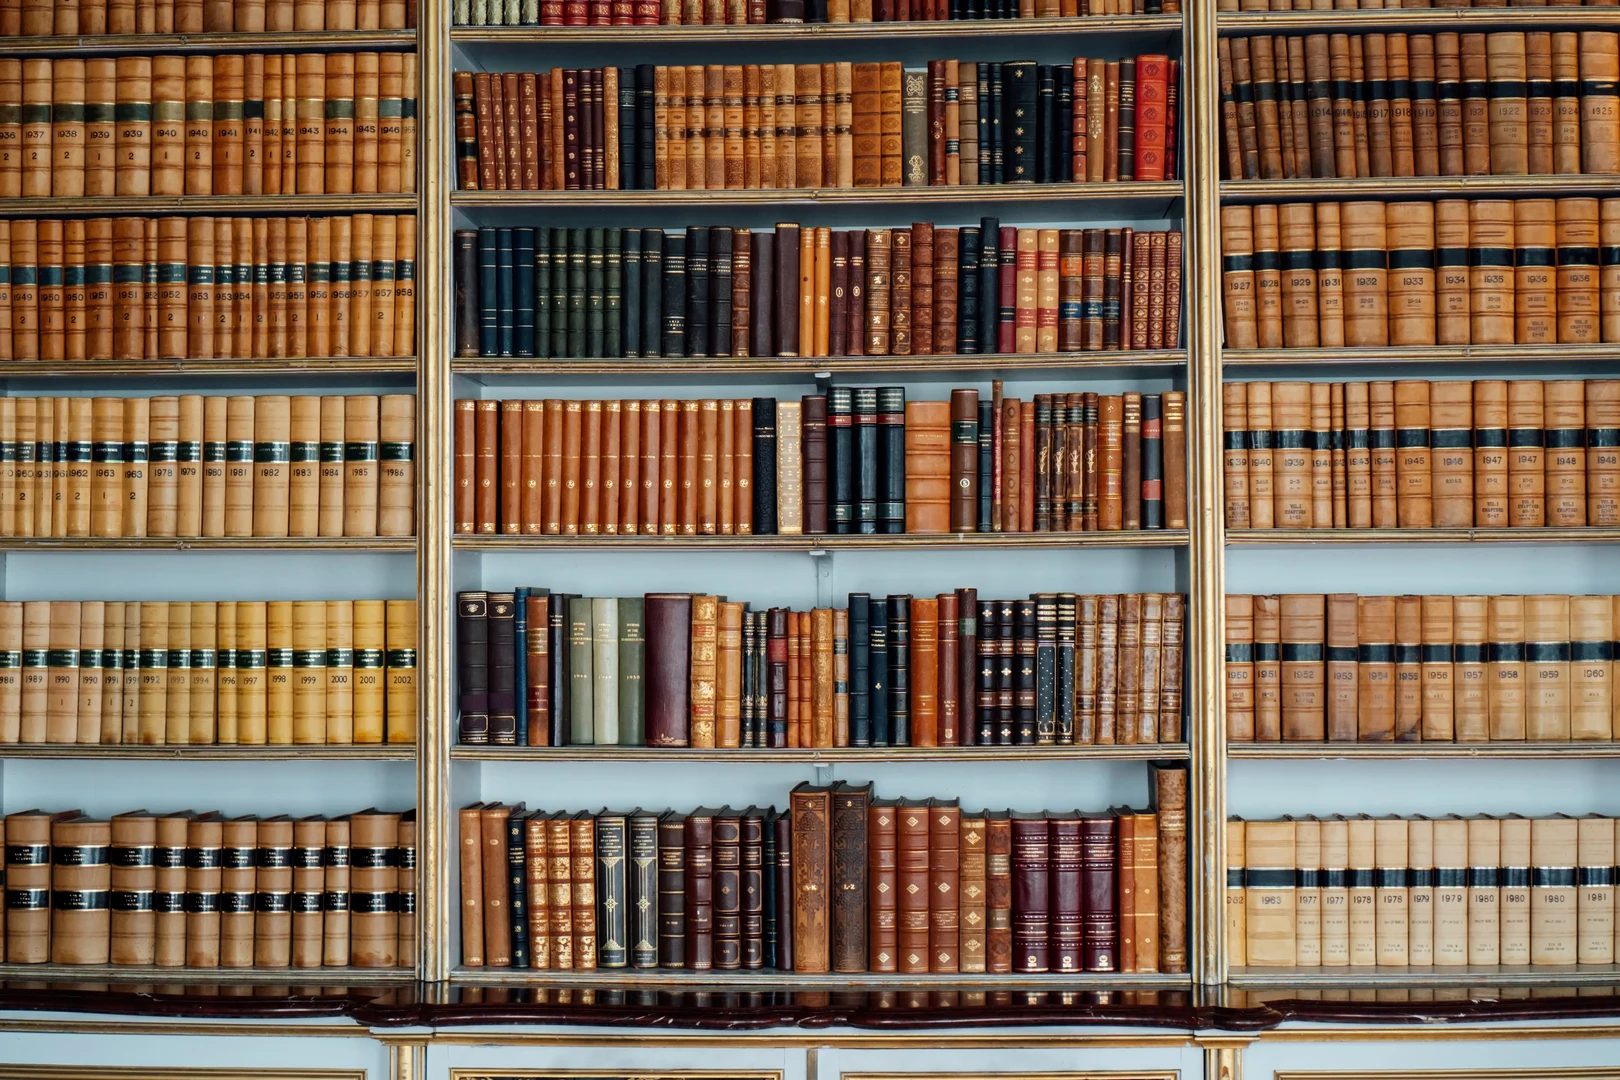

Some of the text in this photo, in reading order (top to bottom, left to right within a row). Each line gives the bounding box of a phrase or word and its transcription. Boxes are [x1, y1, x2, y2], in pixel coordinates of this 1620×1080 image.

[1311, 108, 1332, 117] 1914
[1368, 108, 1389, 118] 1917
[1391, 108, 1411, 117] 1918
[1442, 109, 1459, 117] 1920
[1469, 108, 1484, 116] 1921
[1531, 107, 1551, 115] 1923
[1558, 107, 1578, 115] 1924
[1592, 107, 1612, 115] 1925
[156, 129, 177, 137] 1940
[218, 129, 237, 137] 1941
[300, 127, 319, 135] 1943
[356, 125, 375, 133] 1945
[381, 126, 400, 134] 1946
[25, 131, 44, 139] 1937
[57, 130, 77, 138] 1938
[90, 131, 110, 139] 1939
[123, 130, 143, 138] 1939
[31, 152, 37, 160] 2
[128, 152, 134, 160] 2
[286, 150, 291, 158] 2
[405, 149, 411, 157] 2
[1291, 278, 1311, 286] 1929
[1321, 279, 1340, 287] 1931
[1356, 277, 1377, 285] 1932
[1403, 277, 1424, 285] 1933
[1445, 276, 1466, 284] 1934
[1484, 275, 1504, 283] 1935
[1527, 275, 1547, 283] 1936
[1230, 282, 1251, 290] 1927
[1260, 279, 1279, 288] 1928
[89, 291, 108, 299] 1951
[119, 291, 138, 299] 1951
[160, 291, 181, 299] 1952
[190, 292, 208, 301] 1953
[309, 291, 328, 299] 1956
[331, 290, 350, 298] 1956
[395, 288, 413, 297] 1958
[13, 293, 33, 301] 1949
[40, 293, 60, 301] 1950
[124, 313, 130, 321] 2
[168, 313, 173, 321] 2
[220, 315, 226, 323] 2
[292, 314, 298, 322] 2
[337, 312, 343, 321] 2
[377, 311, 384, 320] 2
[20, 316, 26, 324] 2
[1227, 459, 1247, 467] 1939
[1251, 458, 1271, 466] 1940
[1284, 459, 1305, 467] 1939
[1312, 459, 1331, 467] 1941
[1349, 458, 1370, 466] 1943
[1374, 457, 1394, 465] 1944
[1404, 457, 1425, 465] 1945
[1443, 458, 1463, 466] 1946
[1482, 456, 1502, 465] 1947
[1518, 455, 1537, 463] 1947
[1556, 457, 1577, 465] 1948
[1597, 456, 1617, 464] 1948
[69, 469, 88, 477] 1962
[96, 469, 115, 477] 1963
[124, 470, 143, 479] 1963
[154, 469, 173, 477] 1978
[230, 468, 247, 476] 1981
[261, 469, 280, 477] 1982
[352, 468, 368, 476] 1985
[387, 469, 404, 477] 1986
[56, 492, 61, 500] 2
[75, 492, 80, 500] 2
[130, 492, 136, 500] 2
[1227, 672, 1248, 680] 1950
[1257, 670, 1277, 678] 1951
[1293, 671, 1314, 679] 1952
[1333, 672, 1353, 680] 1953
[1368, 671, 1388, 680] 1954
[1399, 672, 1419, 680] 1955
[1427, 672, 1448, 680] 1956
[1463, 671, 1483, 679] 1957
[1498, 671, 1518, 679] 1958
[1539, 671, 1559, 679] 1959
[1583, 670, 1604, 678] 1960
[25, 675, 43, 683] 1989
[82, 676, 98, 684] 1990
[105, 676, 119, 684] 1991
[143, 675, 160, 684] 1992
[170, 676, 185, 684] 1993
[193, 676, 209, 684] 1994
[221, 676, 236, 684] 1996
[243, 677, 258, 685] 1997
[272, 675, 286, 683] 1998
[301, 676, 316, 684] 1999
[331, 675, 348, 683] 2000
[359, 676, 376, 684] 2001
[393, 676, 412, 684] 2002
[129, 699, 134, 707] 2
[1261, 896, 1282, 904] 1963
[1299, 896, 1317, 904] 1977
[1326, 896, 1344, 904] 1977
[1353, 896, 1372, 904] 1978
[1383, 895, 1402, 903] 1978
[1414, 895, 1430, 903] 1979
[1475, 895, 1494, 903] 1980
[1544, 895, 1565, 903] 1980
[1587, 893, 1606, 901] 1981
